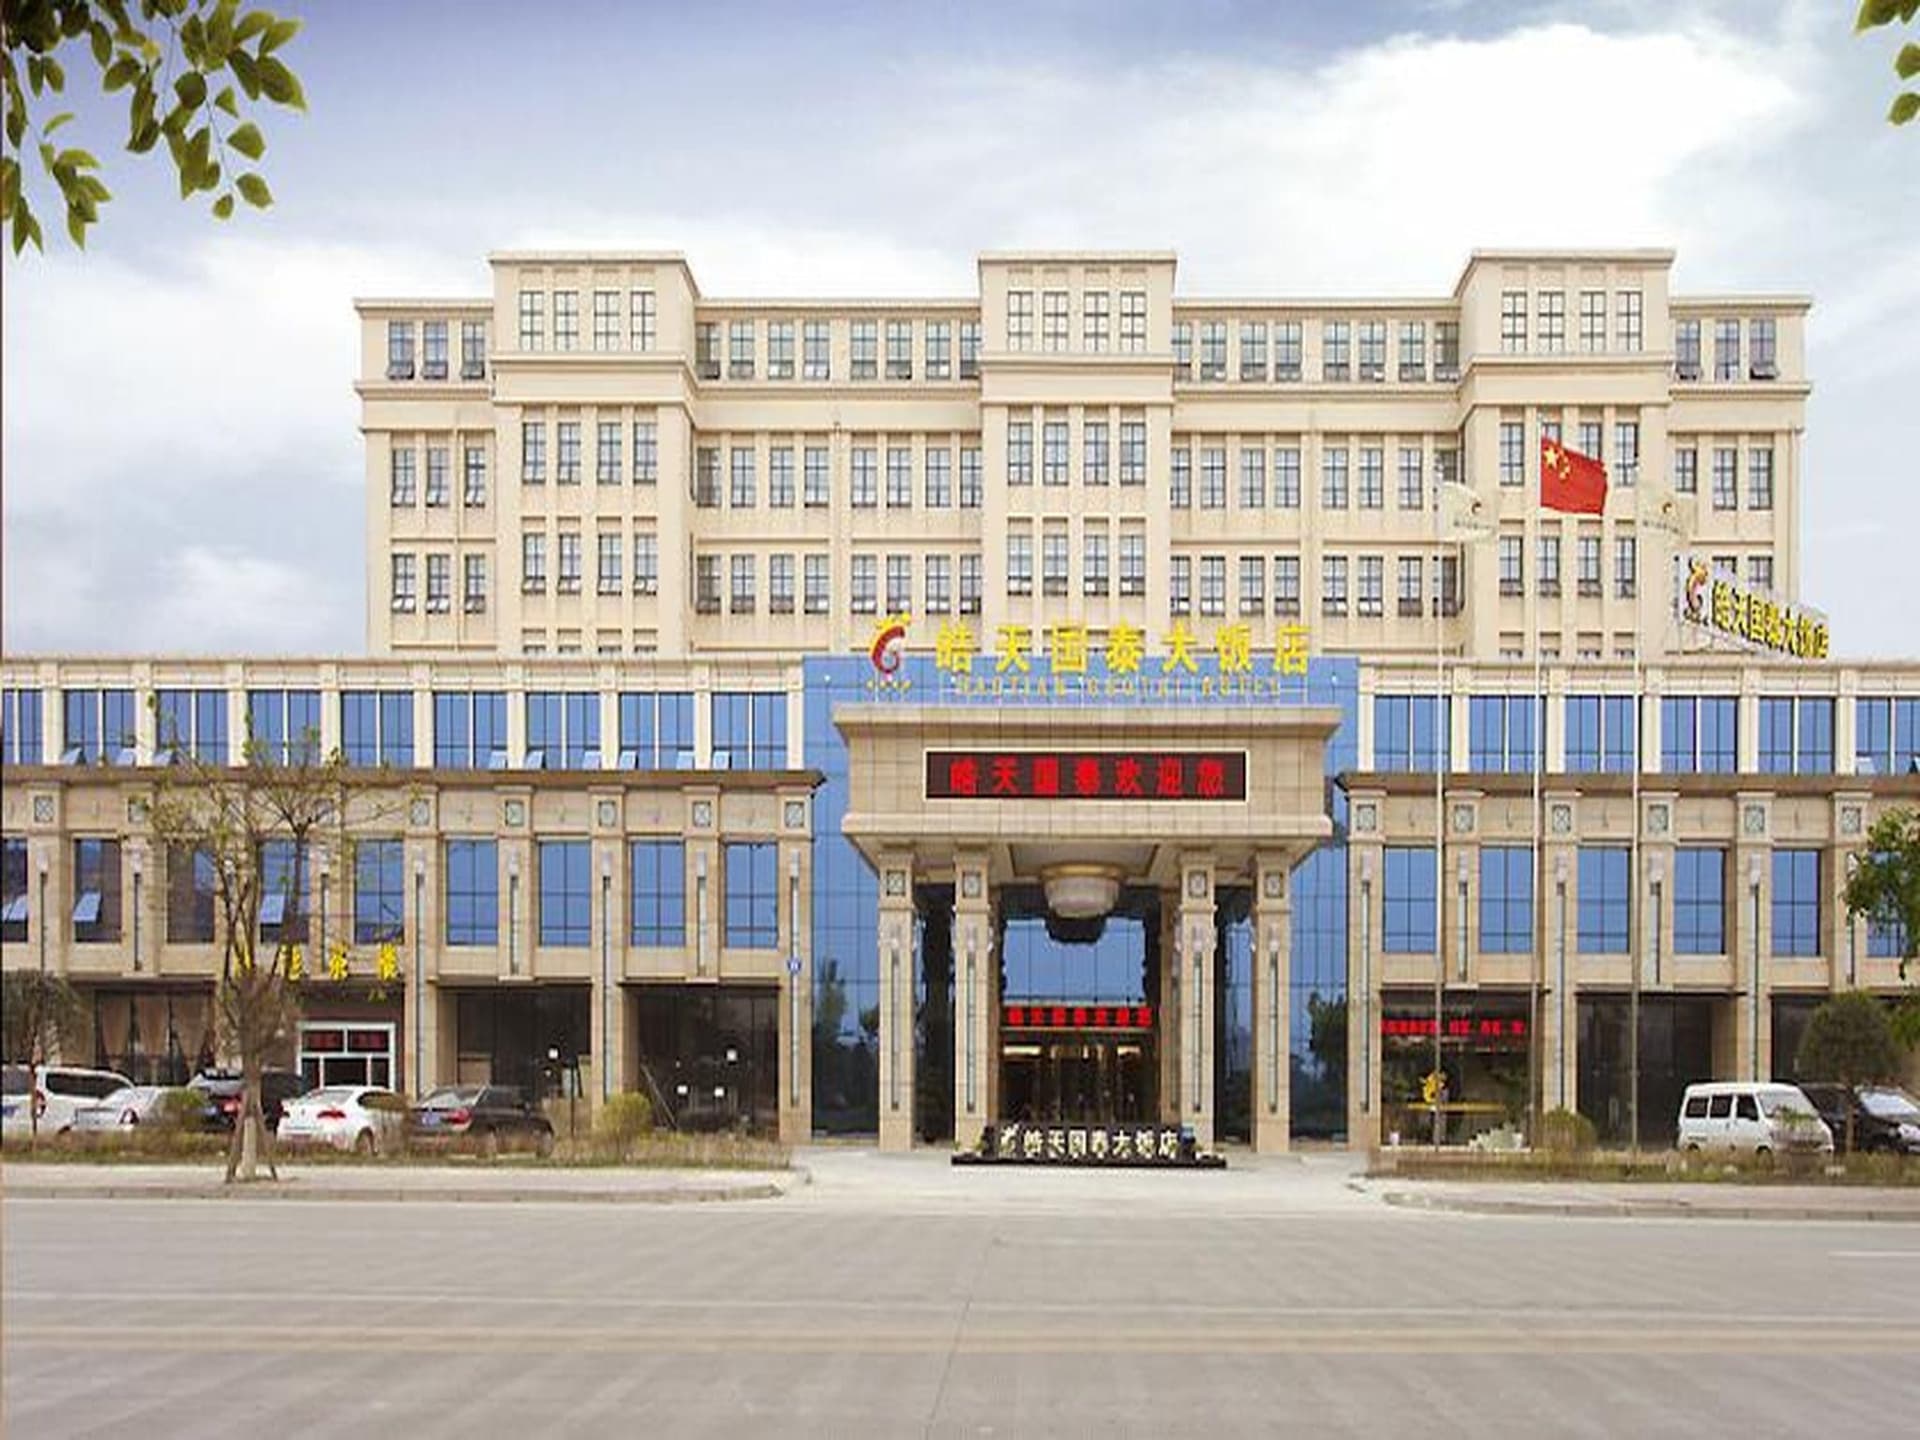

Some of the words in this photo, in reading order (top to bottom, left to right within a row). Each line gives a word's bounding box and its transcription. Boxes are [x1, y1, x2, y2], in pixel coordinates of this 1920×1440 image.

[935, 621, 1312, 675] 皓天国泰大饭店
